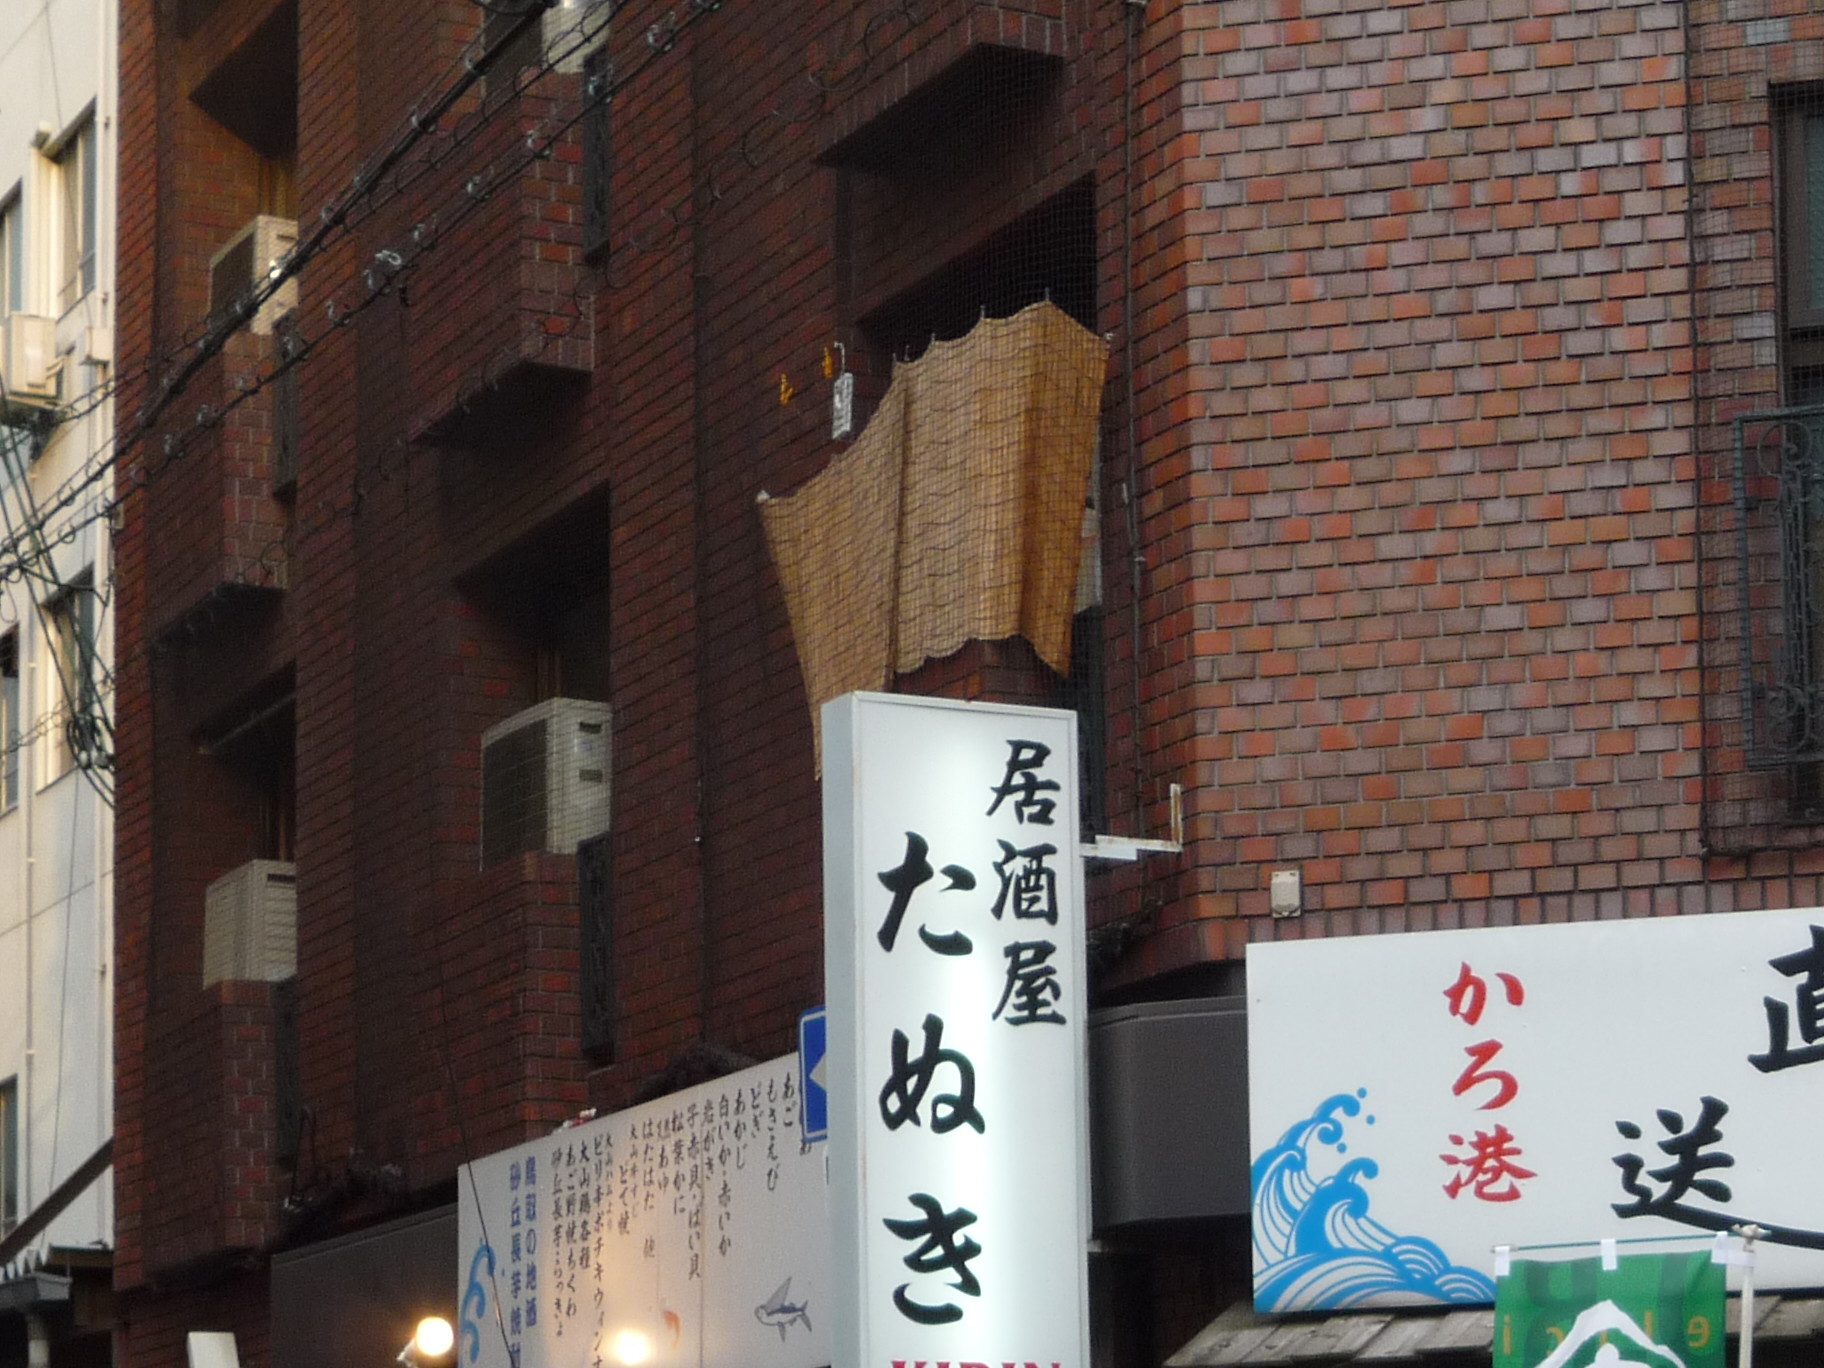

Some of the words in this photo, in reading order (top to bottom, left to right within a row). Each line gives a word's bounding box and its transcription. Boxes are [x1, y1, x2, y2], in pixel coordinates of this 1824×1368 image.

[986, 740, 1067, 1027] 居酒屋
[877, 831, 985, 1325] たぬき
[1439, 962, 1538, 1202] かろ港
